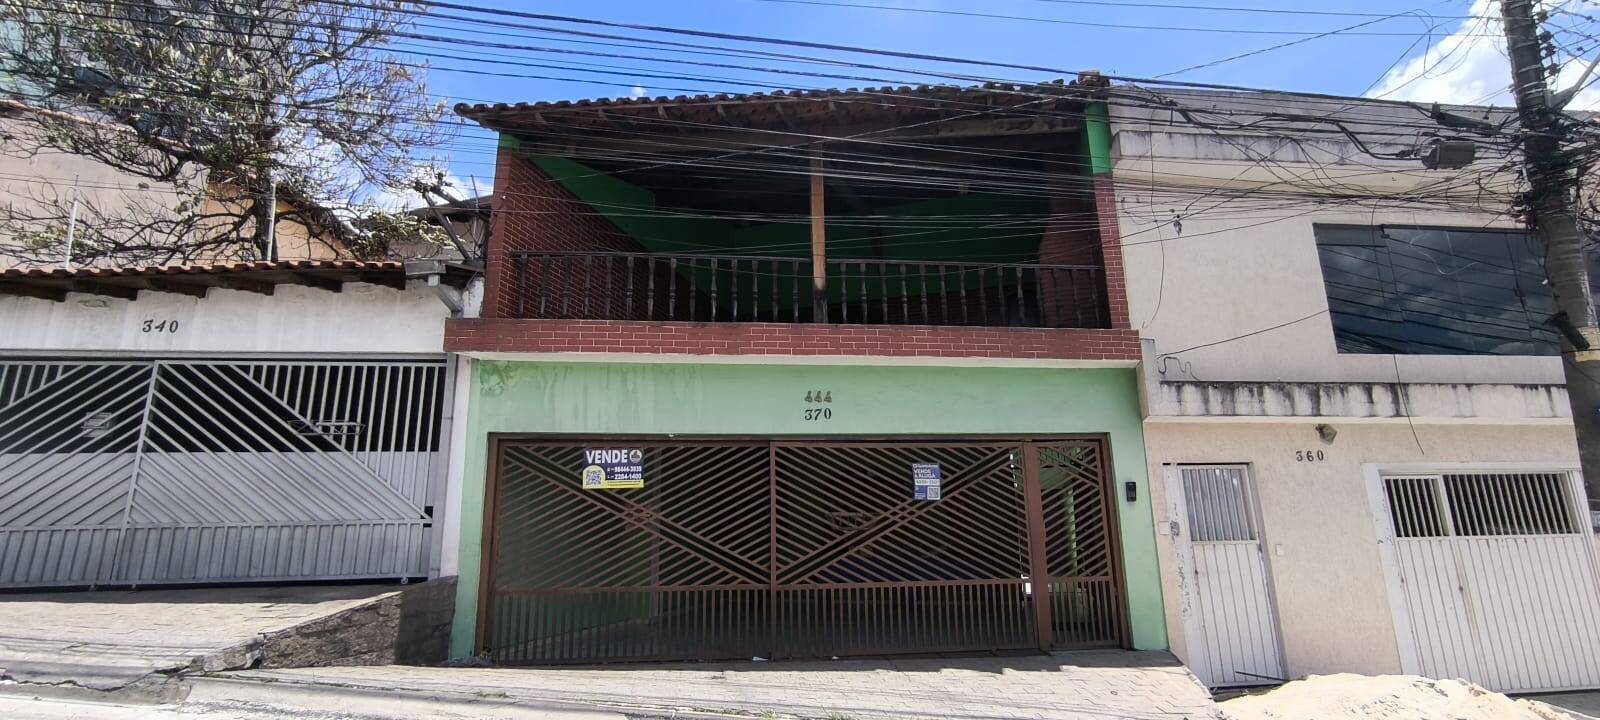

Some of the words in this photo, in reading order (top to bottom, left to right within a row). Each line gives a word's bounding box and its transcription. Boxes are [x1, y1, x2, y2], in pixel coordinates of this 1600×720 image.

[142, 319, 179, 333] 340
[804, 407, 832, 421] 370
[585, 449, 628, 464] VENDE
[1295, 449, 1324, 462] 360
